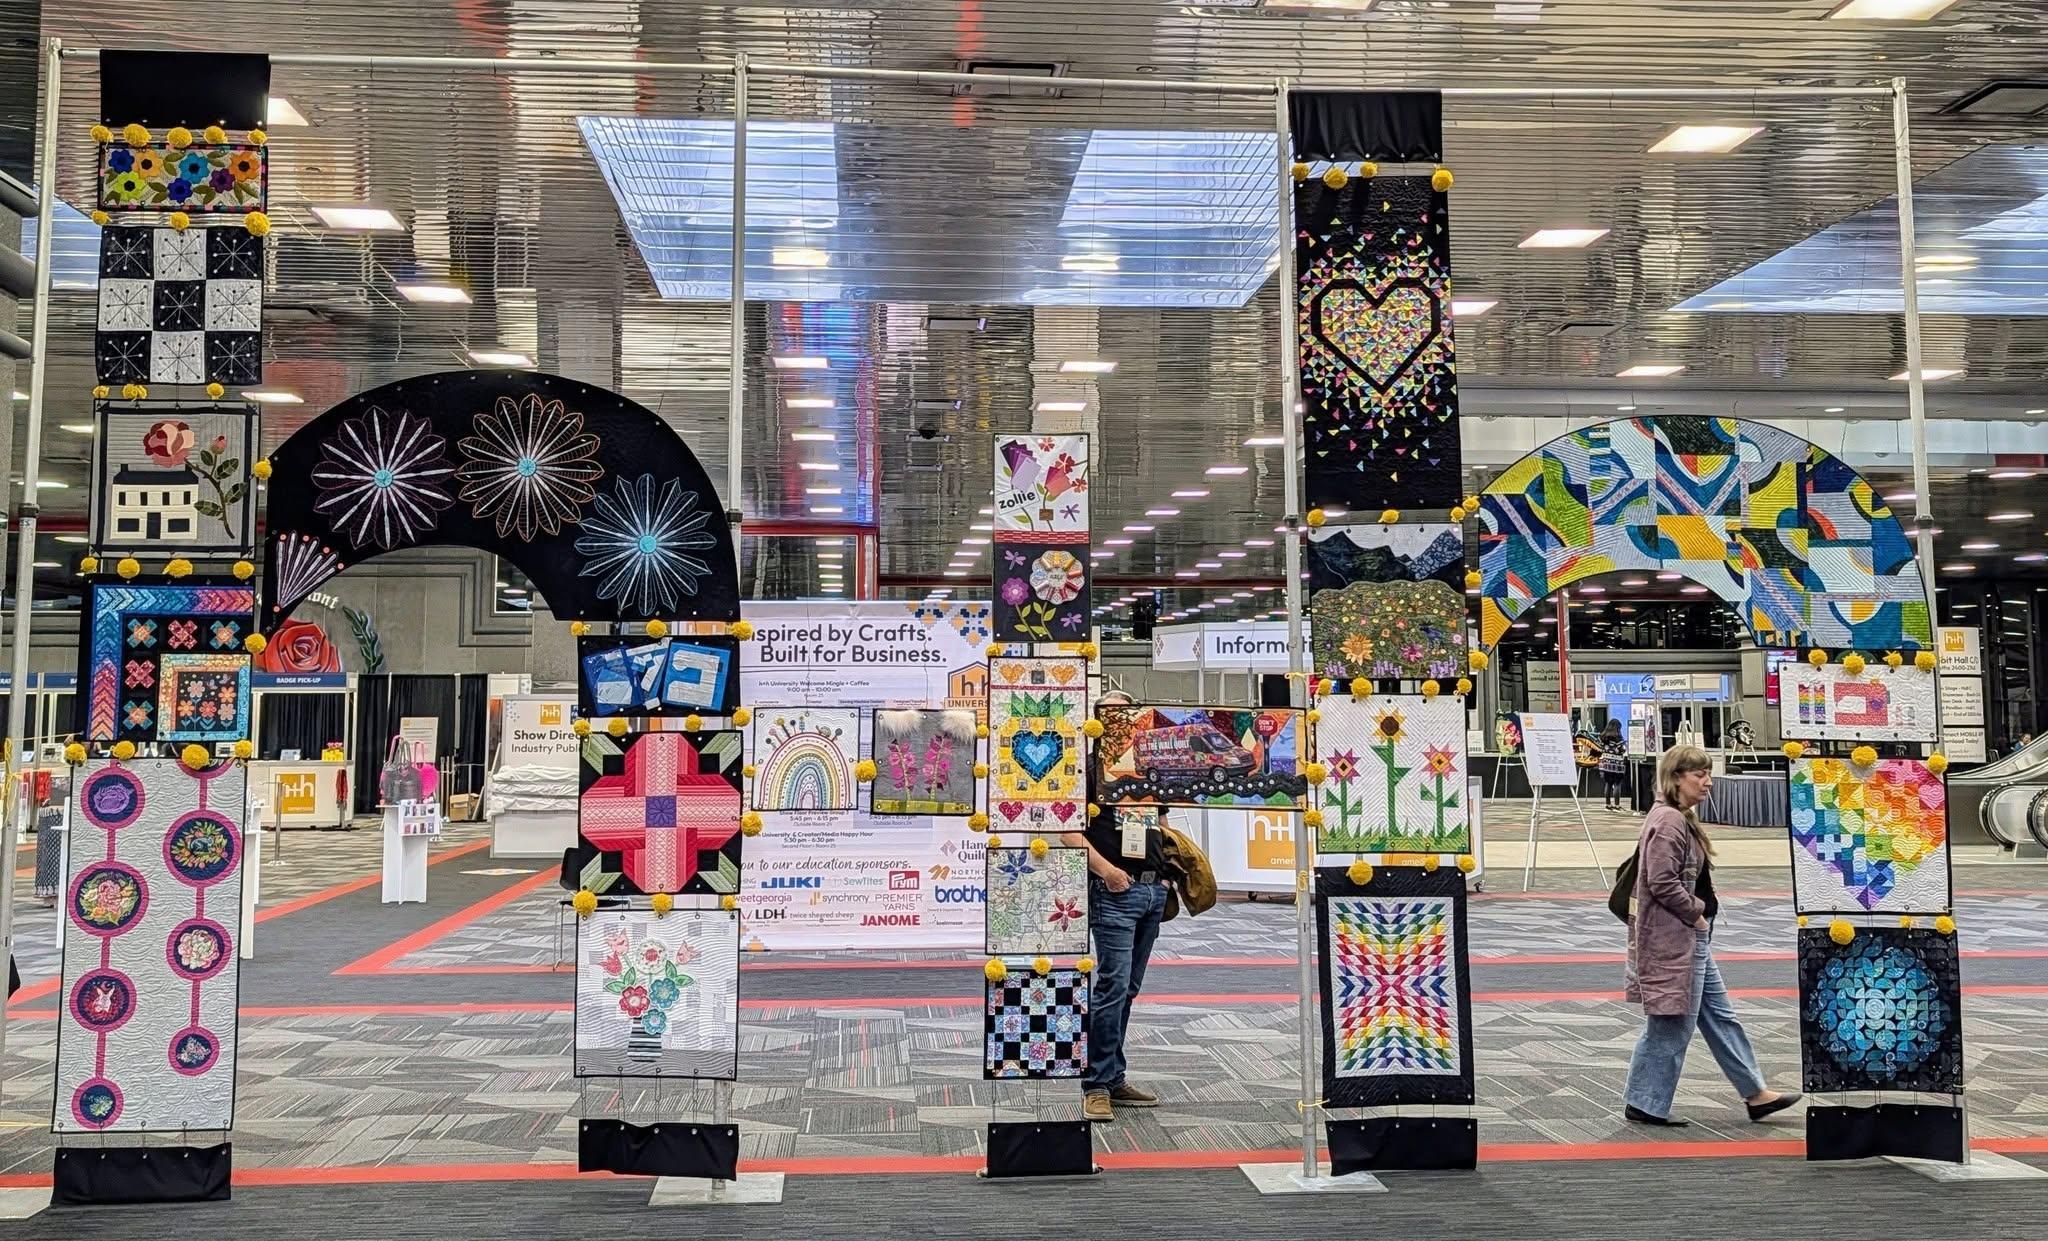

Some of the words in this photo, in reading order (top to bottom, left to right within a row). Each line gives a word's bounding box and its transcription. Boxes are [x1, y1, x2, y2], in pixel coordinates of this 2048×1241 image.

[998, 491, 1036, 509] zollie
[751, 624, 822, 648] nspired
[828, 624, 853, 646] by
[858, 624, 932, 642] Crafts.
[1216, 635, 1312, 654] Informti
[760, 645, 808, 663] Built
[813, 645, 846, 663] for
[852, 645, 947, 663] Business.
[1941, 656, 1952, 664] bit
[1102, 673, 1123, 690] EN
[542, 706, 560, 717] h+h
[514, 730, 546, 740] Show
[511, 744, 553, 755] Industry
[741, 861, 754, 870] ou
[760, 859, 769, 871] to
[772, 861, 793, 870] our
[795, 856, 853, 870] education
[855, 860, 911, 874] sponsors.
[761, 877, 821, 888] JUKI
[843, 878, 884, 886] SewTites
[891, 873, 918, 888] Prym
[735, 892, 793, 905] weetgeorgia
[822, 893, 869, 906] synchrony
[875, 894, 923, 902] PREMIER
[835, 911, 854, 920] sheep
[860, 915, 920, 926] JANOME
